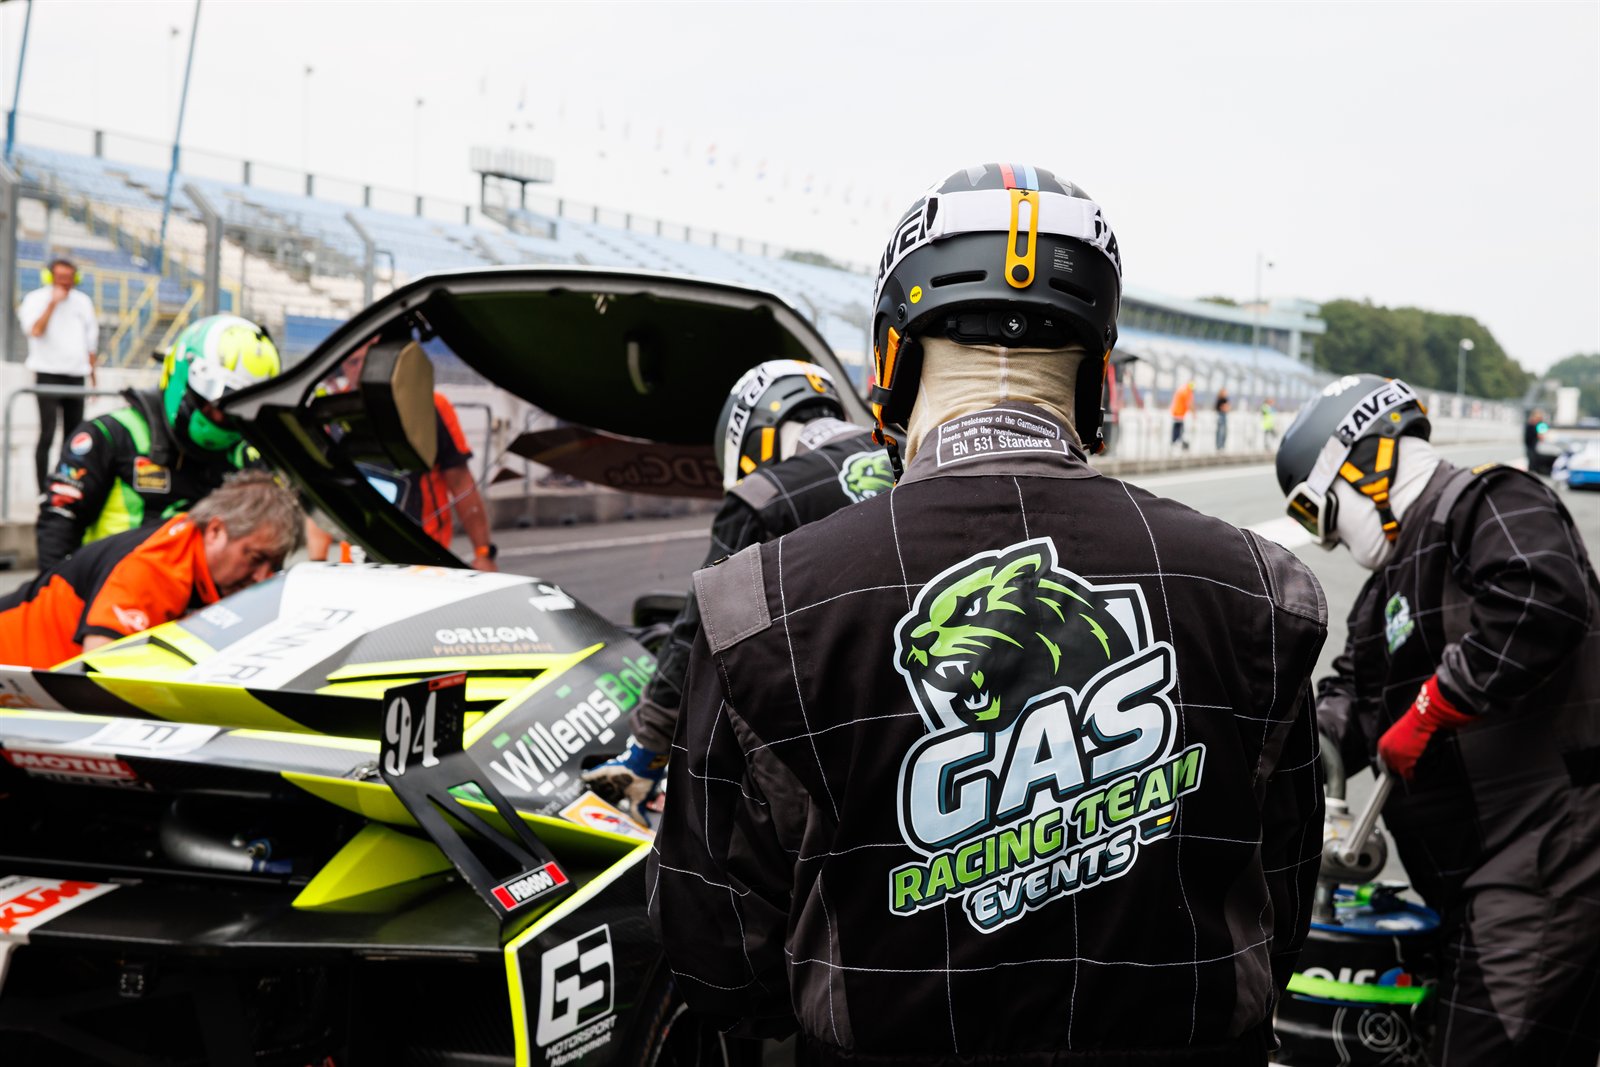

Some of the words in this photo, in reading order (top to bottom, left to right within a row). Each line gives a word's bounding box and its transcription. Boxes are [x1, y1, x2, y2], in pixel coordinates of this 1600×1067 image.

[963, 427, 978, 438] with
[980, 425, 992, 435] the
[995, 414, 1003, 423] of
[1004, 415, 1015, 426] the
[952, 439, 969, 457] EN
[974, 435, 994, 452] 531
[998, 435, 1052, 449] Standard
[435, 626, 540, 645] ORIZON
[385, 691, 440, 777] 94
[908, 652, 1168, 848] GAS
[11, 752, 131, 776] MOTUL
[893, 808, 1066, 911] RACING
[1073, 748, 1201, 836] TEAM
[507, 870, 554, 902] FERODO
[971, 828, 1136, 927] EVENTS
[545, 1014, 619, 1060] MOTORSPORT
[550, 1031, 612, 1067] Management
